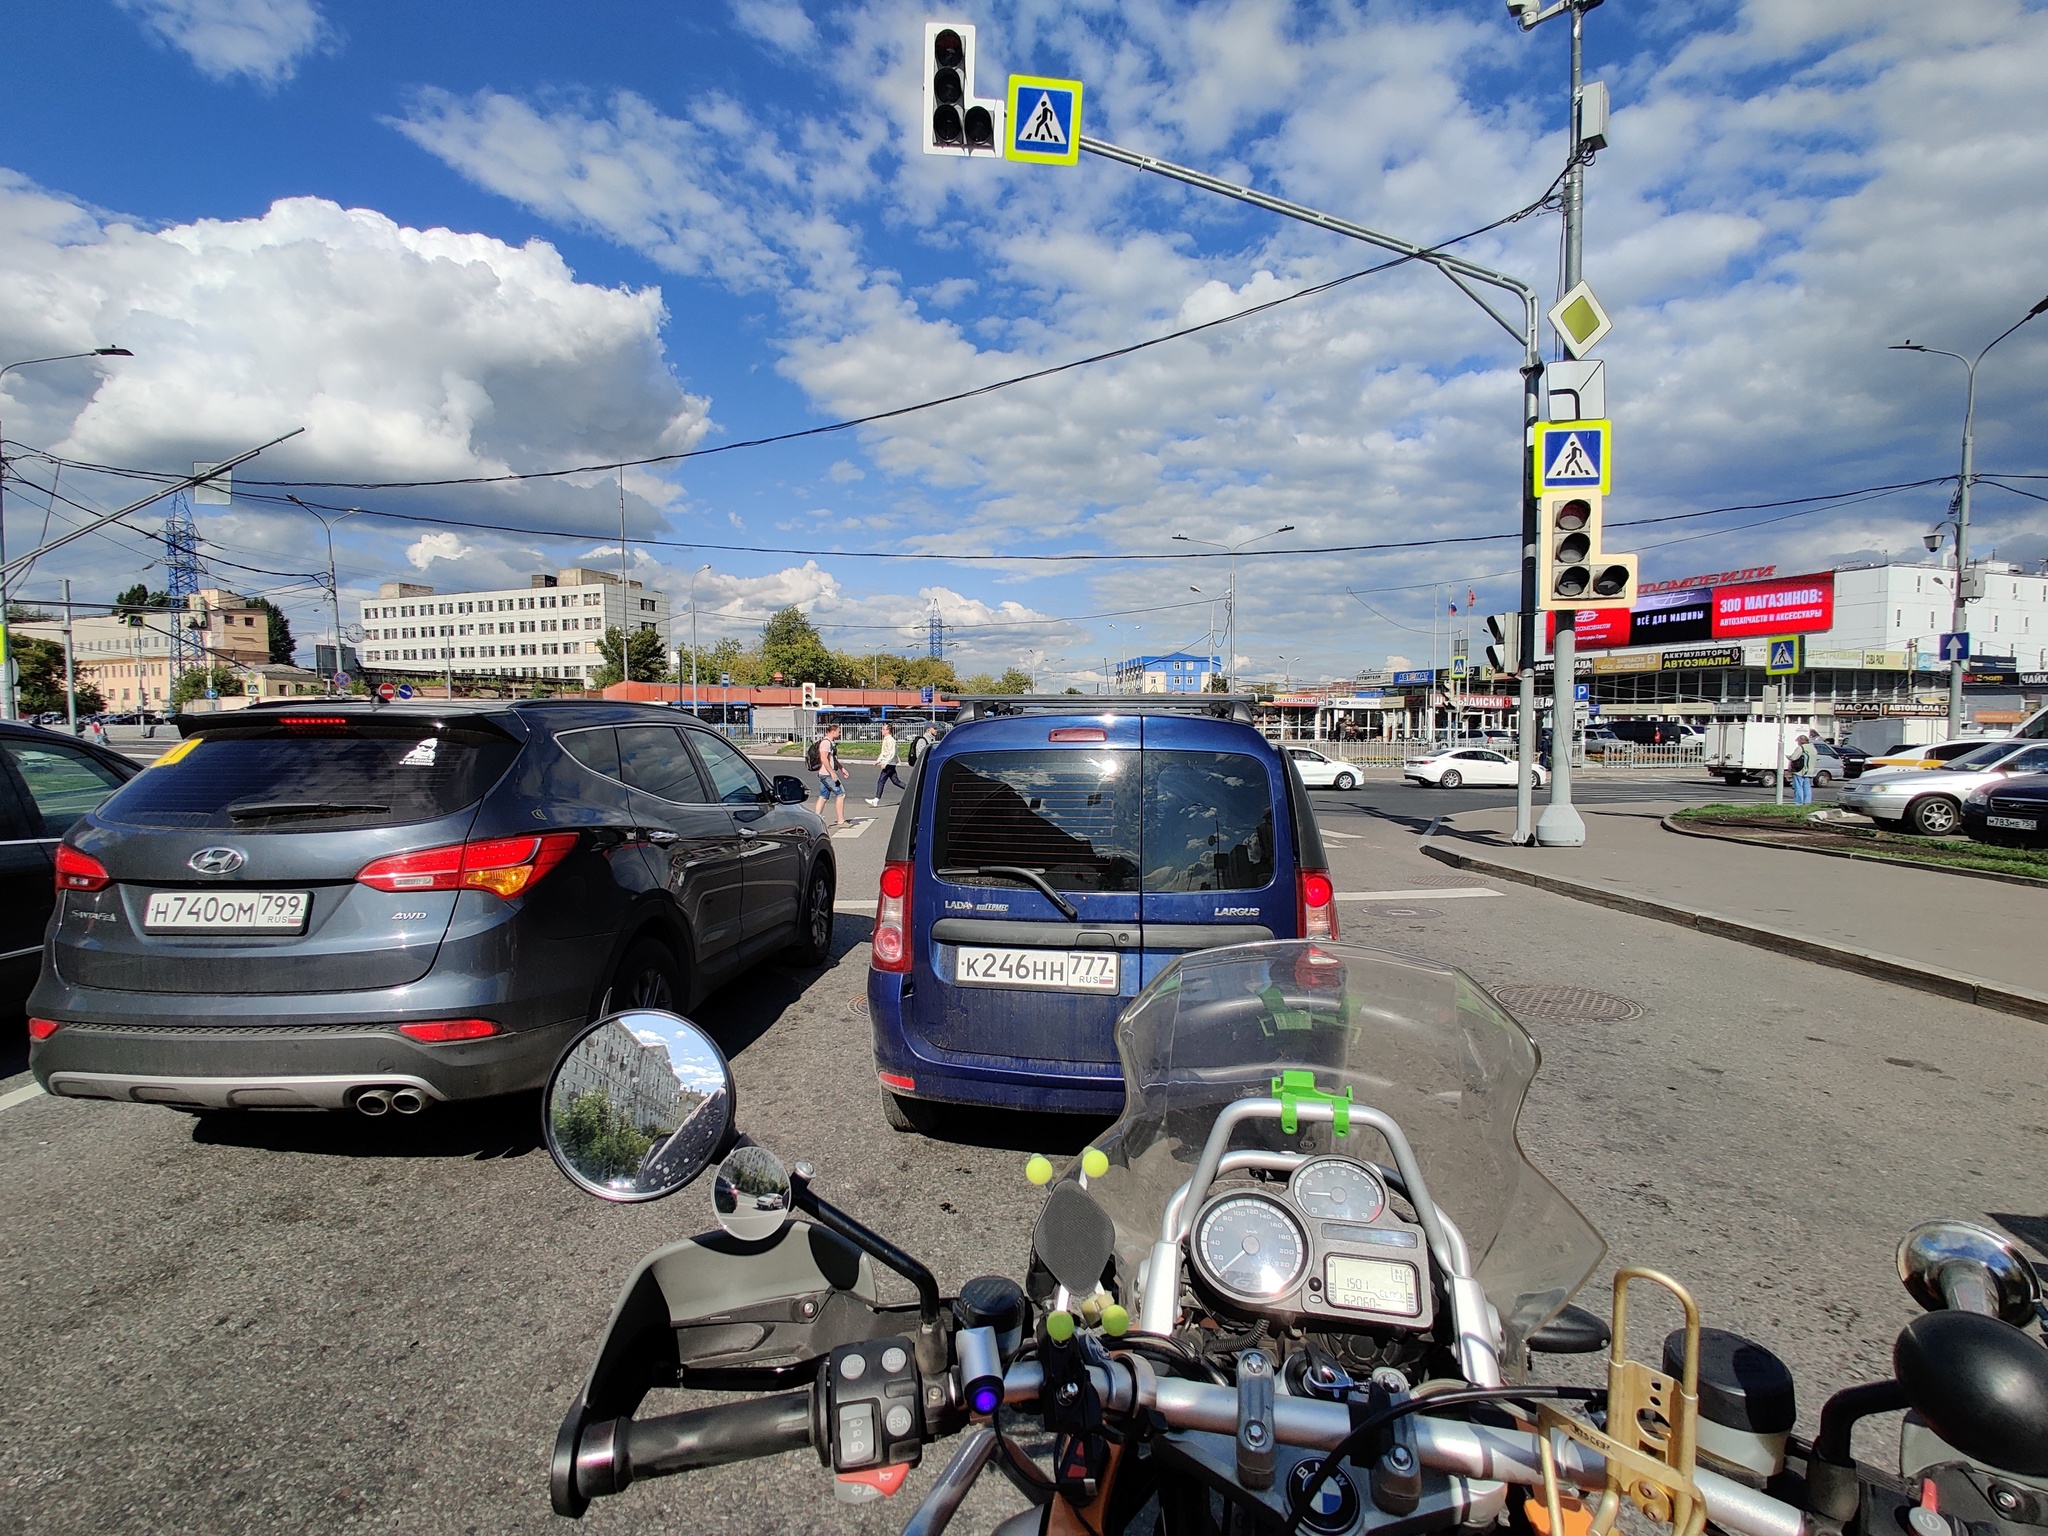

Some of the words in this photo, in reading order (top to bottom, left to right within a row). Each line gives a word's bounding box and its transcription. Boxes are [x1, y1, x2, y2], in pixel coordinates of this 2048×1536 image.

[1720, 598, 1741, 613] 300
[1744, 588, 1822, 610] МАГАЗИНОВ:
[1636, 614, 1650, 626] ВСЁ
[1652, 614, 1666, 625] ДЛЯ
[1670, 610, 1704, 622] МАШИНЫ
[1720, 614, 1768, 626] АВТОЗАПЧАСТИ
[1776, 609, 1822, 621] АКСЕССУАРЫ
[1664, 649, 1730, 660] АККУМУЛЯТОРЫ
[1664, 656, 1730, 668] АВТОЭМАЛИ
[1470, 698, 1502, 707] ДИСКИ
[1835, 703, 1879, 712] МАСЛА
[1888, 704, 1940, 712] АВТОМАСЛА
[154, 897, 255, 922] Н740ОМ
[262, 896, 301, 916] 799
[944, 900, 970, 909] LADA
[392, 912, 427, 920] 4WD
[1214, 908, 1260, 916] LARGUS
[268, 916, 288, 924] RUS
[966, 953, 1064, 982] К246НН
[1070, 956, 1109, 976] 777
[1078, 976, 1098, 984] RUS
[843, 1360, 862, 1368] INFO
[890, 1416, 908, 1428] ESA
